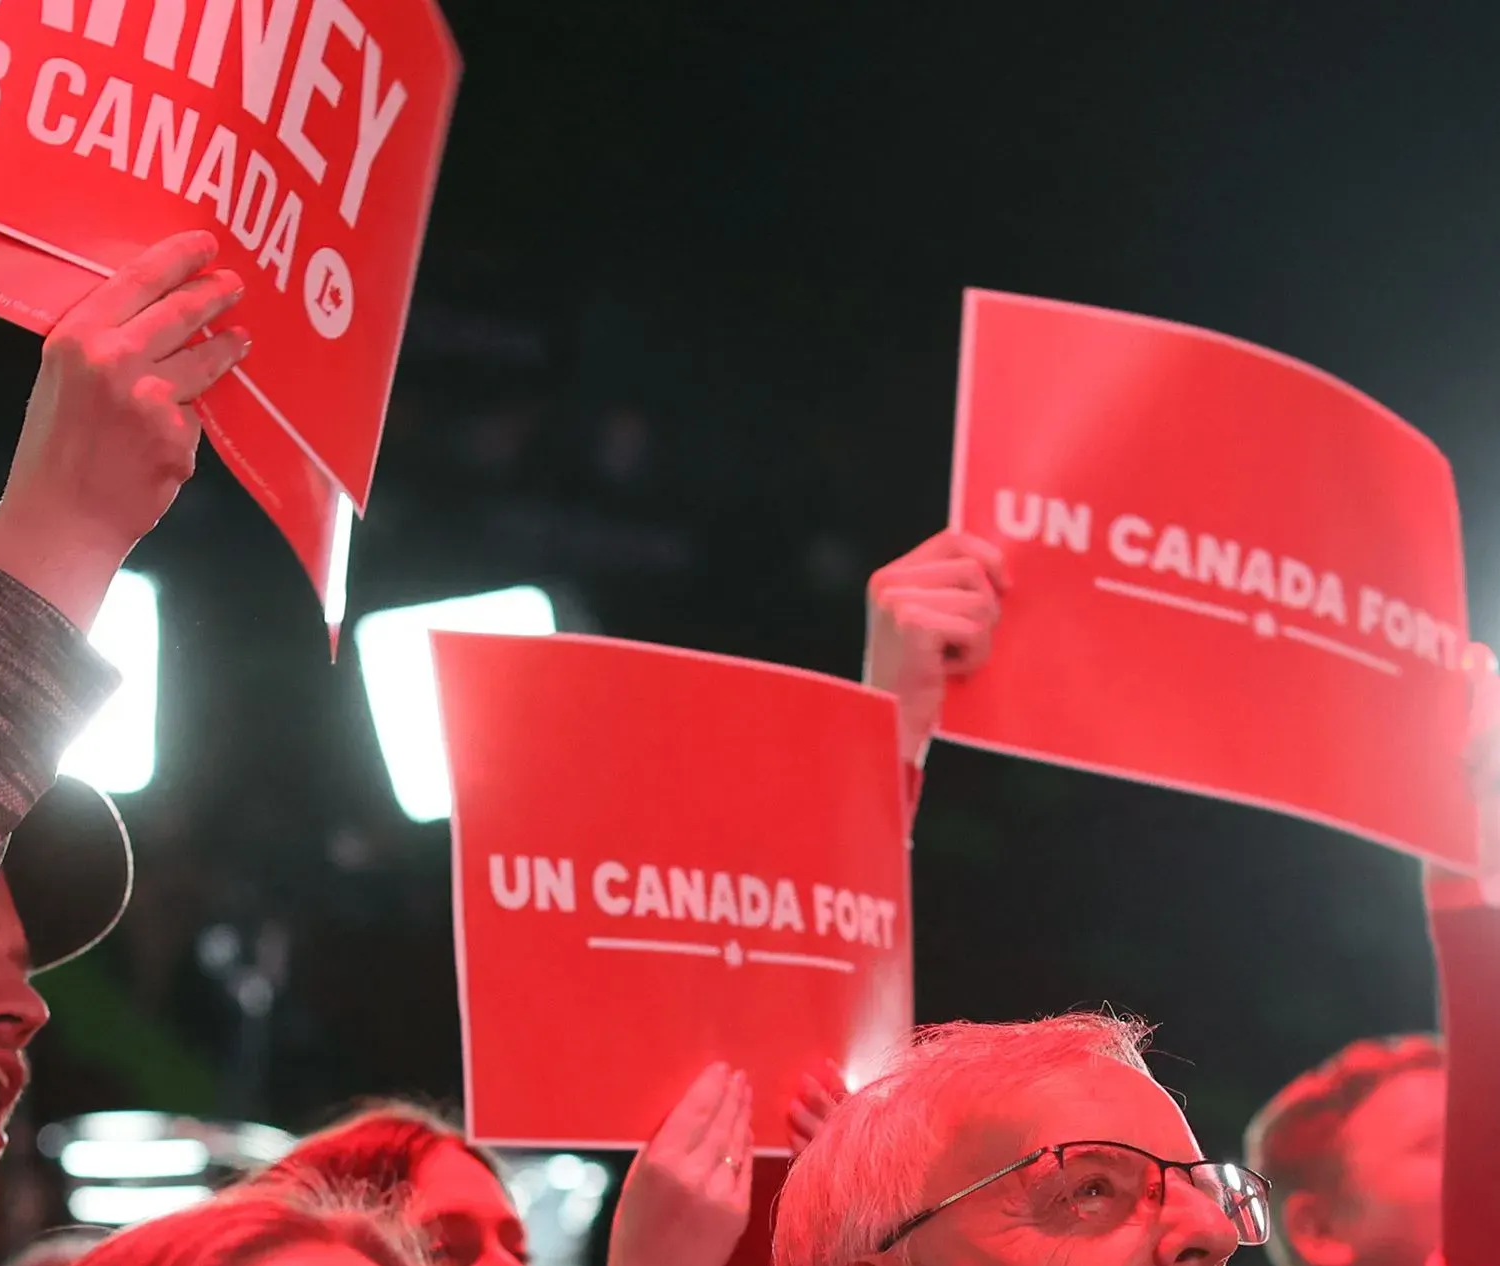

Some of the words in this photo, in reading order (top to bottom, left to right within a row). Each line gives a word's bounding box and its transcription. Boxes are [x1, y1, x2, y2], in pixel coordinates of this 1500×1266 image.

[26, 57, 303, 293] CANADA
[995, 488, 1093, 554] UN
[1108, 514, 1346, 624] CANADA
[1358, 587, 1458, 670] FORT
[488, 853, 577, 914] UN
[592, 859, 804, 932] CANADA
[813, 884, 898, 948] FORT
